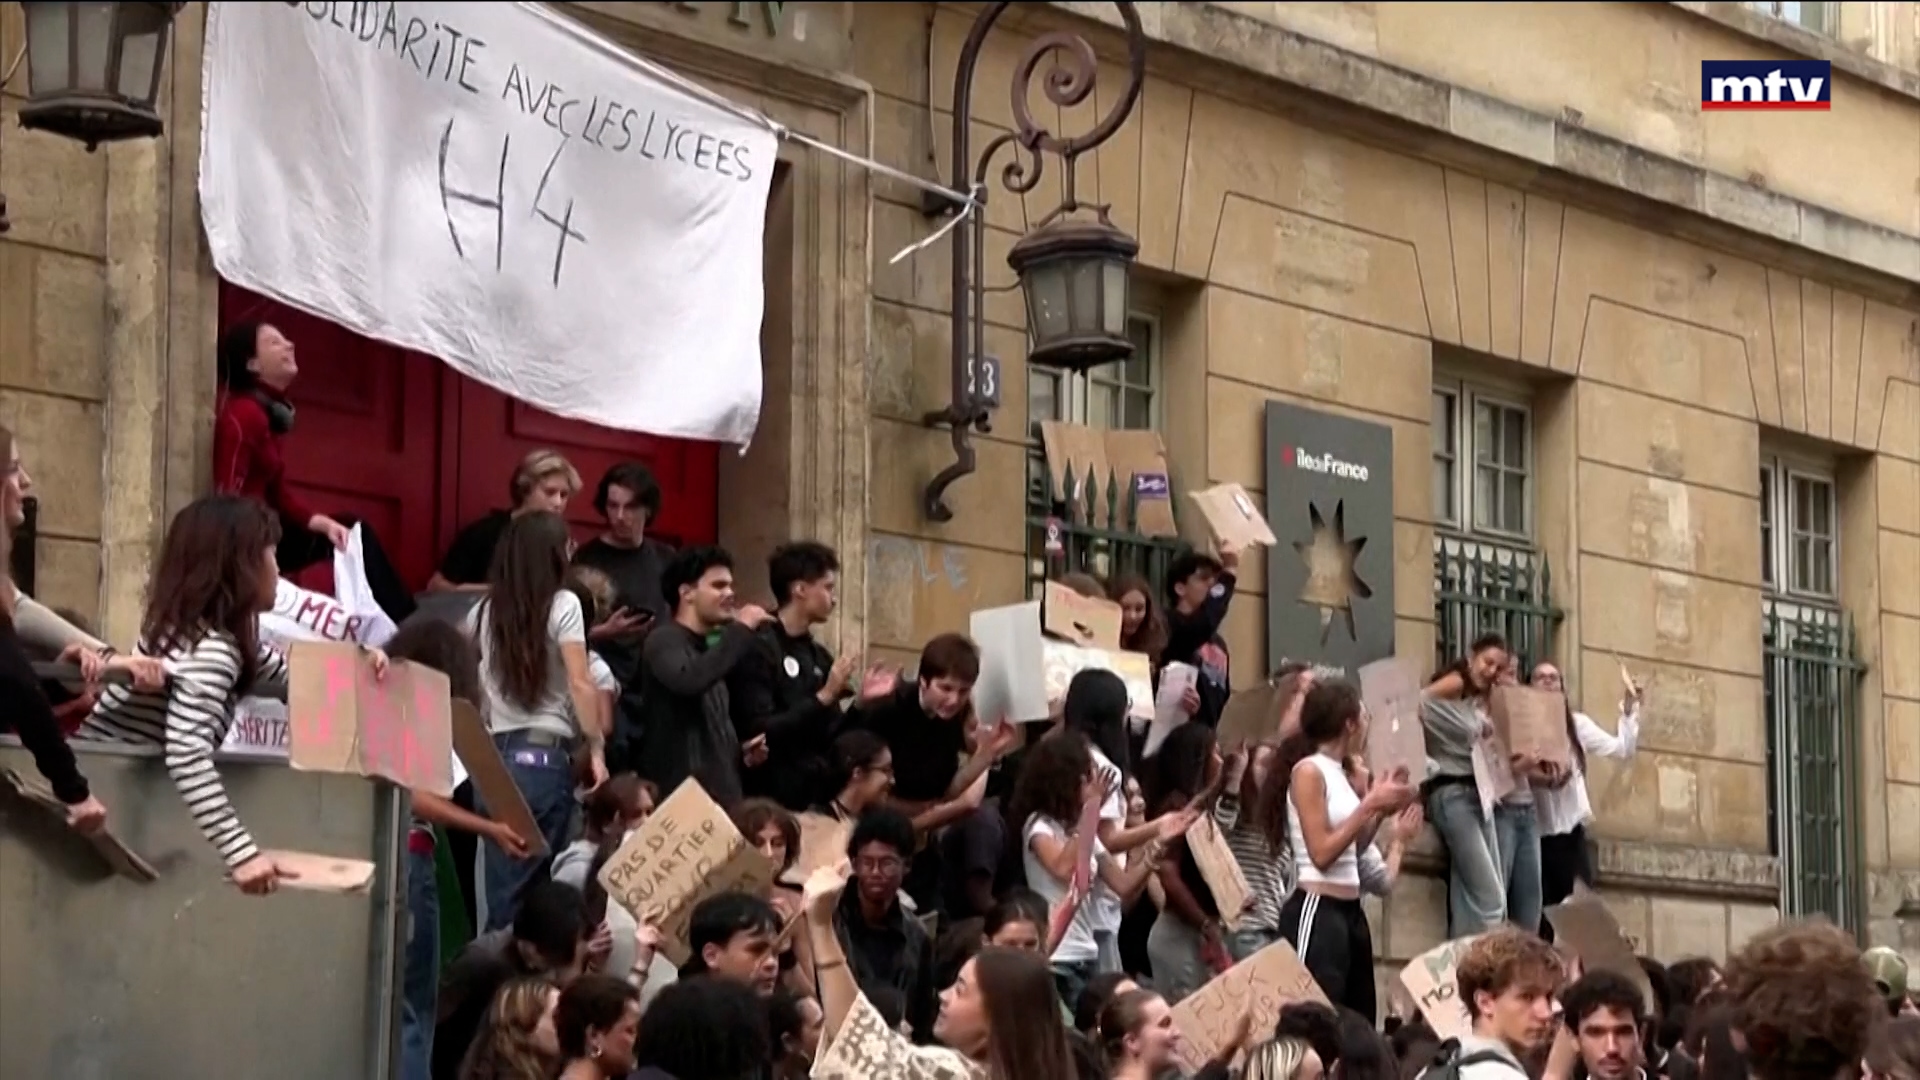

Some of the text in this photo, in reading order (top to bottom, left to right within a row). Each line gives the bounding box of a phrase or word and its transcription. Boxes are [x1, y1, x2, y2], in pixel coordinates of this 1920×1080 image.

[285, 2, 752, 181] LIDARiTE AVEC LES LYCEES
[438, 118, 588, 288] H4
[608, 817, 677, 890] PAS DE
